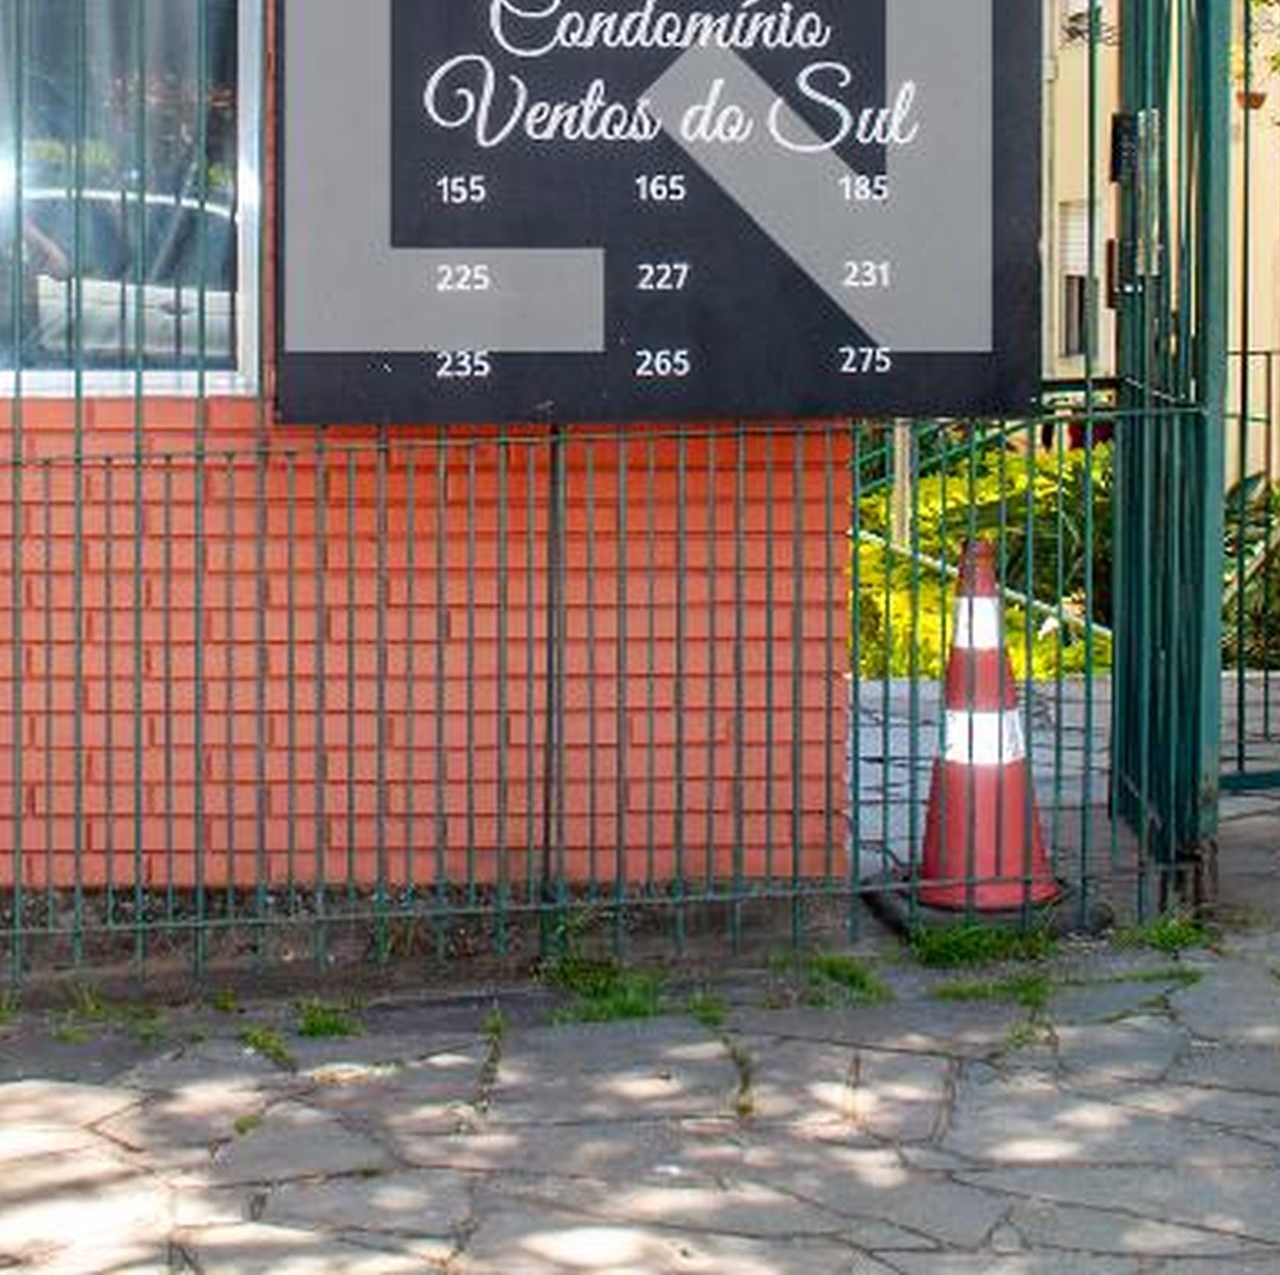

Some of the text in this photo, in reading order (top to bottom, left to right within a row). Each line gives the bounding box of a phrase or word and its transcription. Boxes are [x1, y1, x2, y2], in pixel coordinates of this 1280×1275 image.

[423, 54, 920, 153] Ventos do Sul
[436, 176, 486, 203] 155
[635, 175, 687, 201] 165
[839, 174, 890, 201] 185
[436, 264, 491, 292] 225
[637, 264, 690, 290] 227
[843, 260, 891, 288] 231
[436, 351, 491, 377] 235
[635, 350, 691, 376] 265
[839, 347, 892, 373] 275
